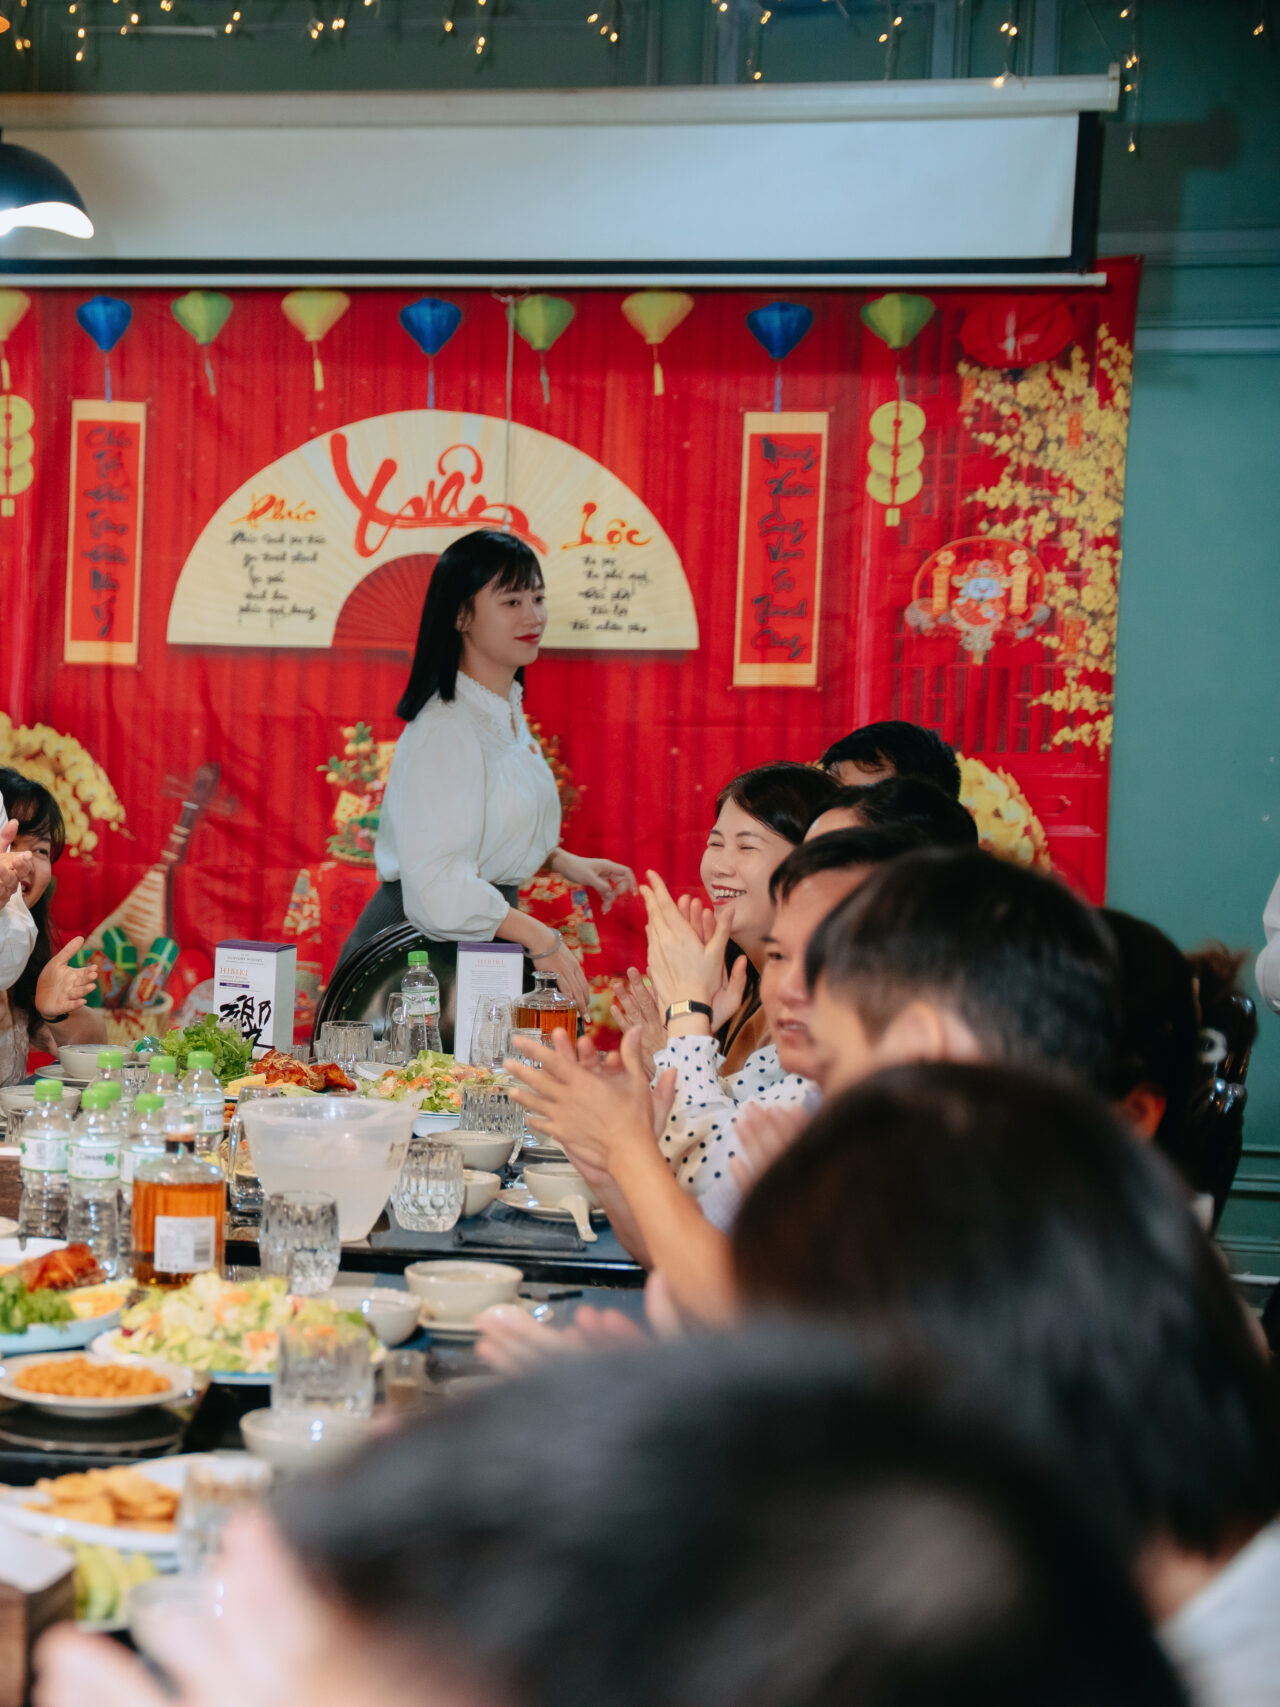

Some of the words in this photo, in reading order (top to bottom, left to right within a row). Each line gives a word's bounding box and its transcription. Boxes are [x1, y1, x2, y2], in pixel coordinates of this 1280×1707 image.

[329, 432, 549, 559] Xuân
[560, 501, 654, 551] Lộc
[219, 967, 249, 977] HIBIKI
